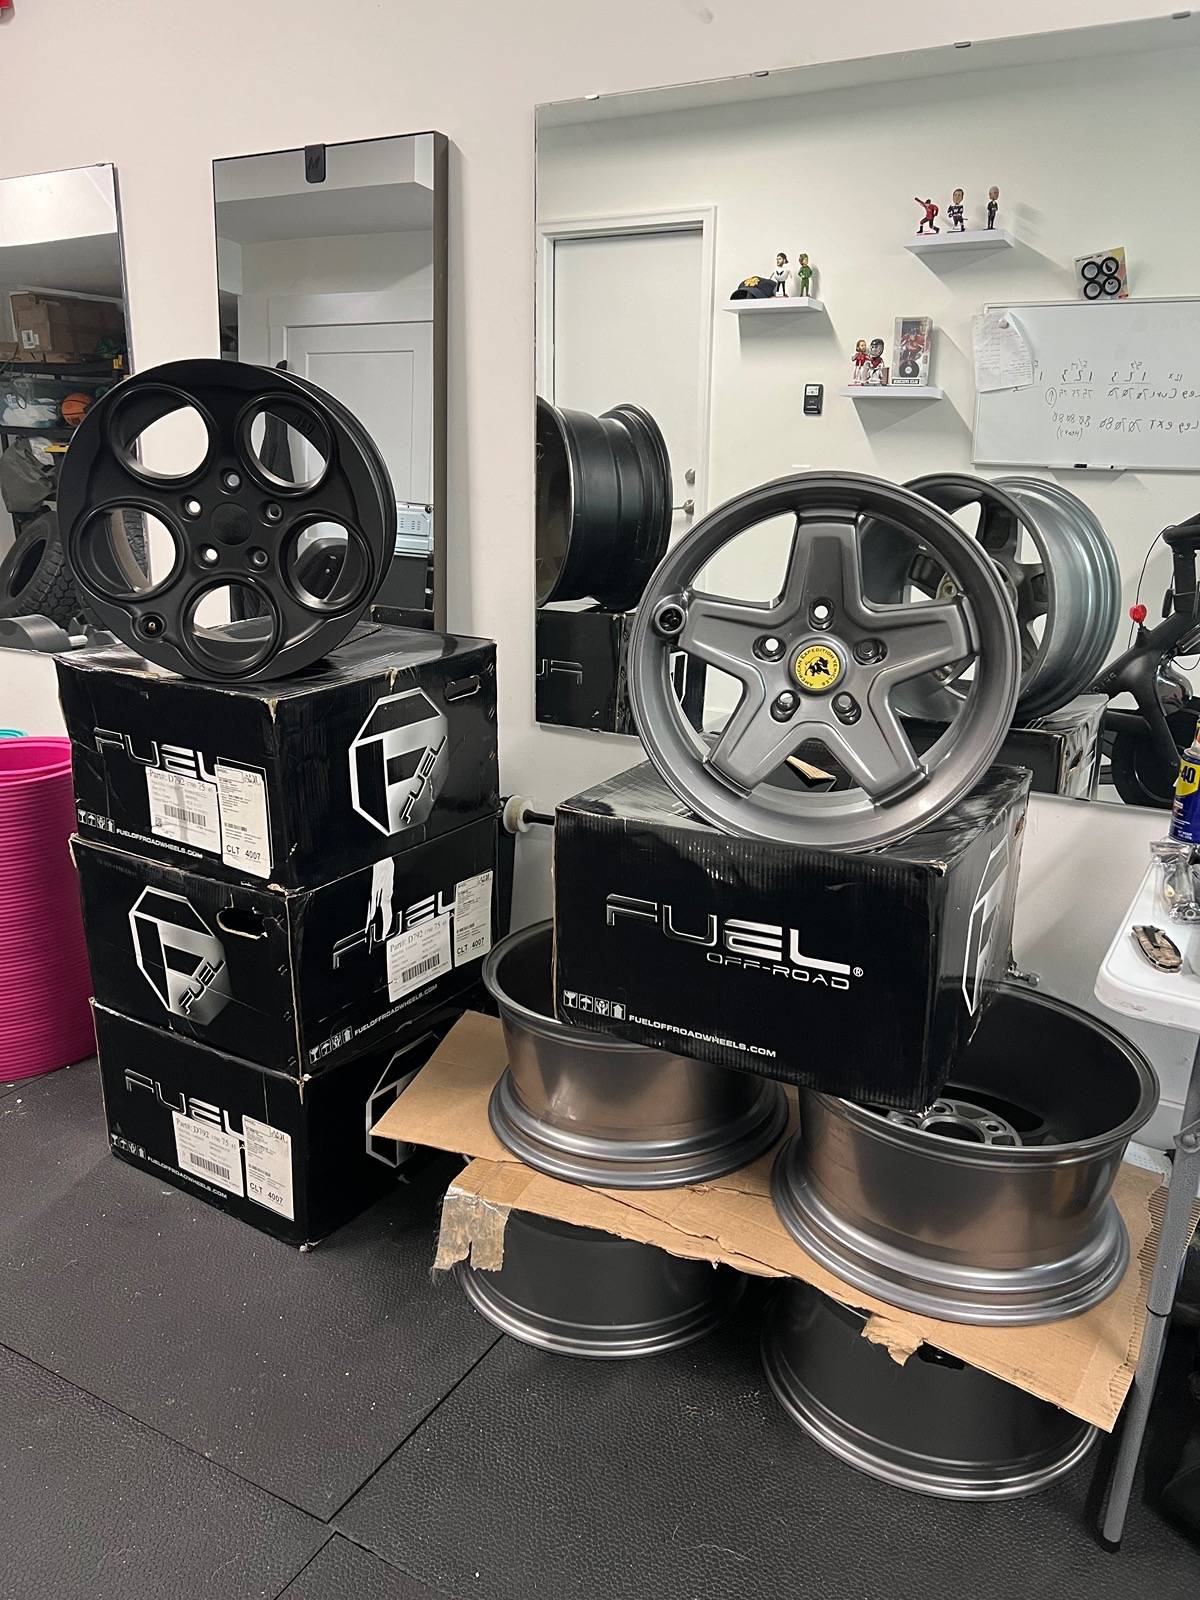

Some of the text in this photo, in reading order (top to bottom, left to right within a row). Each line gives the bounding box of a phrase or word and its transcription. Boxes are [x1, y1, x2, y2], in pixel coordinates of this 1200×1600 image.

[796, 647, 838, 687] AMERICAN EXPEDITION VEHICLES
[94, 727, 217, 784] FUEL
[116, 827, 203, 859] FUELOFFROADWHEELS.COM
[226, 844, 261, 861] CLT 4007
[456, 937, 485, 955] CLT 4007
[606, 893, 851, 975] FUEL
[706, 952, 850, 990] OFF-ROAD
[354, 983, 438, 1036] FUELOFFROADWHEELS.COM
[629, 1014, 777, 1058] FUELOFFROADWHEELS.COM
[124, 1068, 244, 1140] FUEL
[147, 1156, 228, 1200] FUELOFFROADWHEELS.COM
[249, 1182, 284, 1203] CLT 4007
